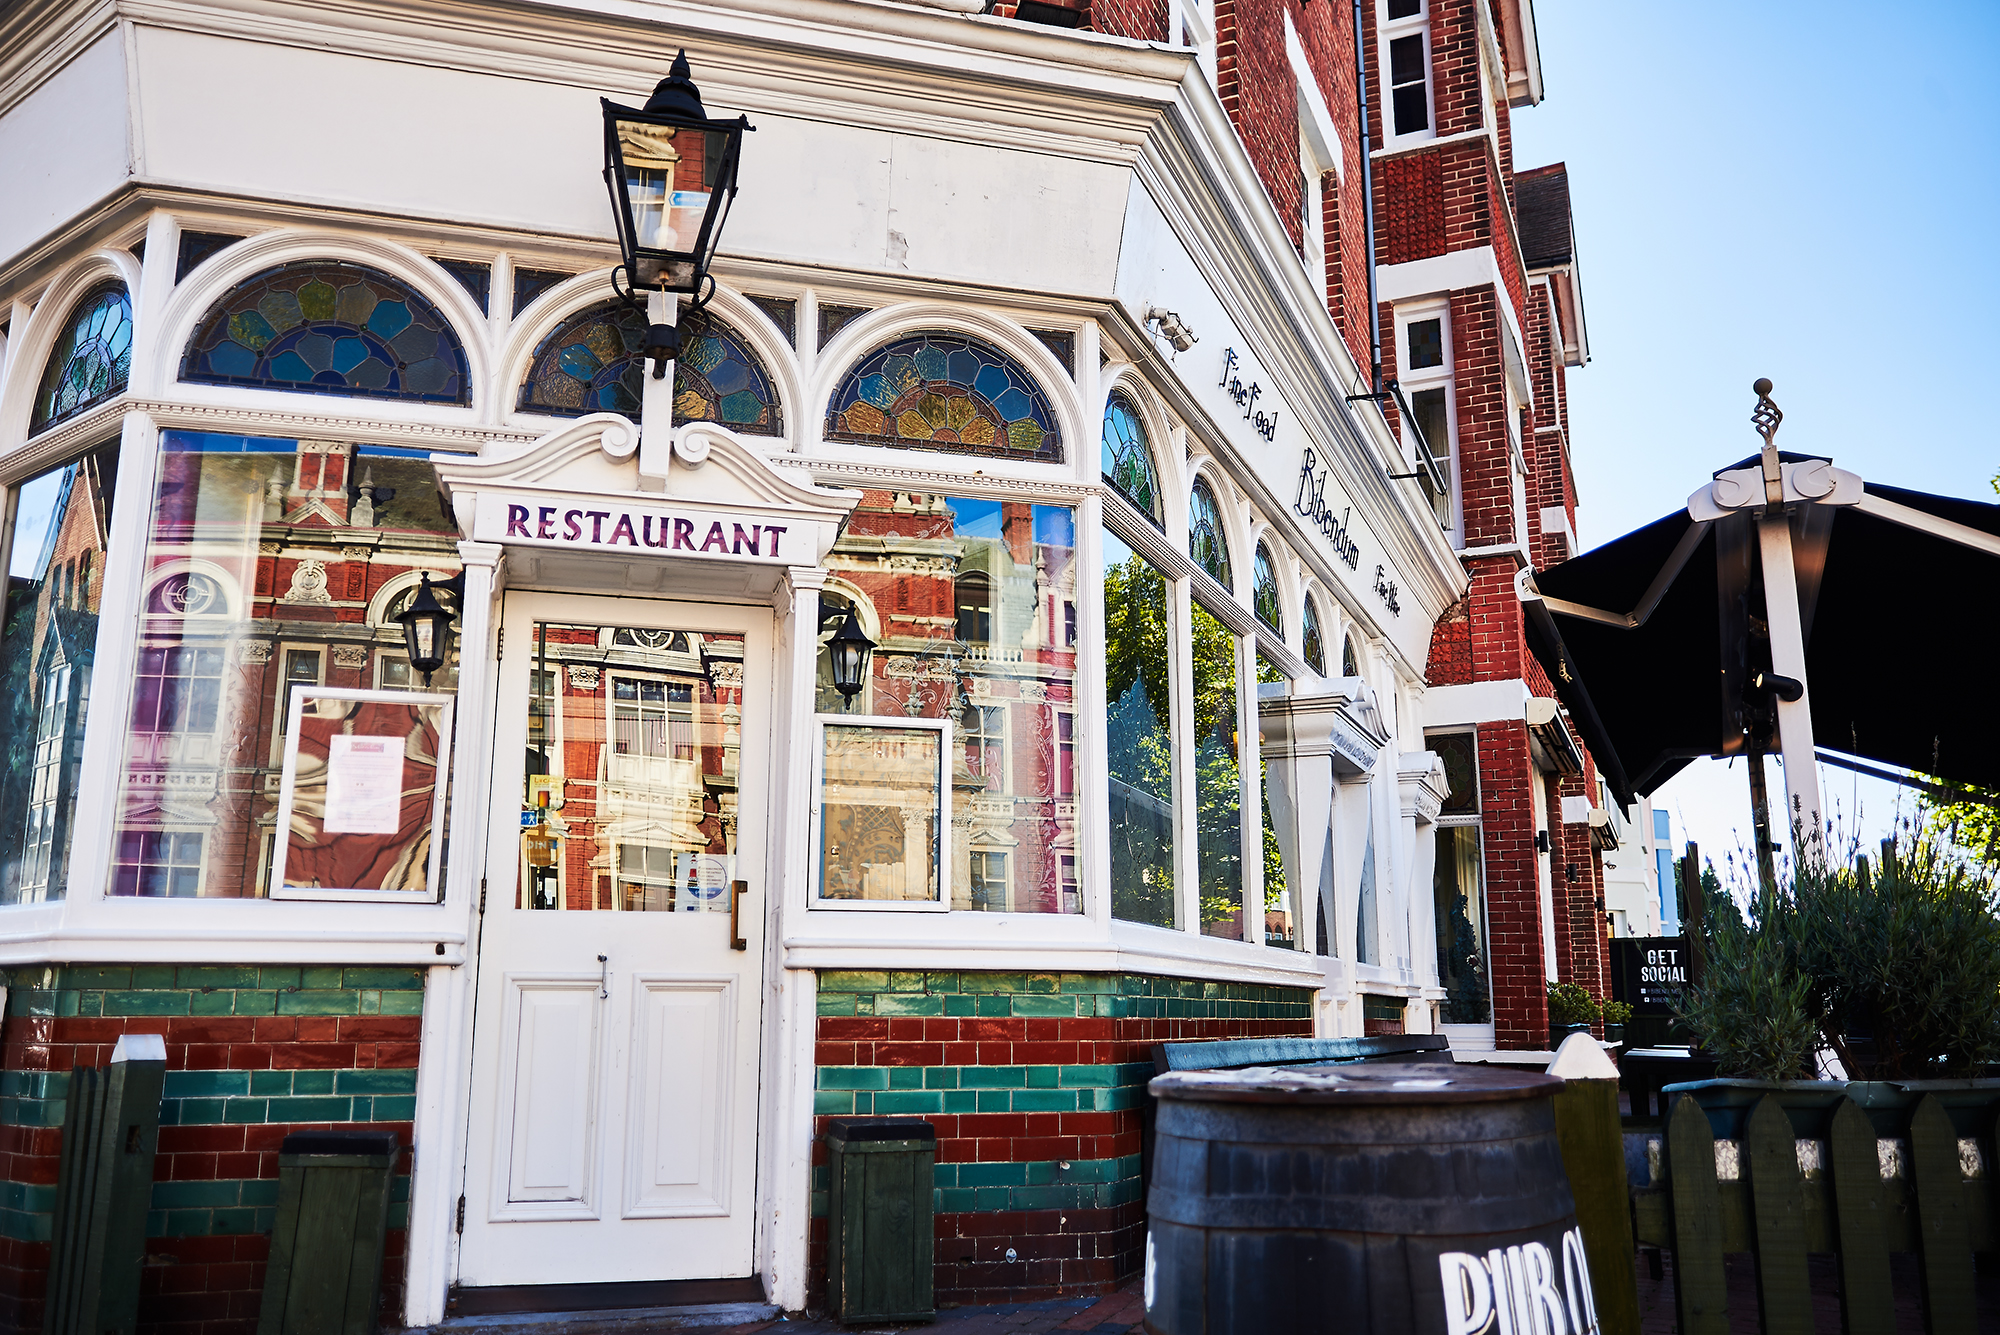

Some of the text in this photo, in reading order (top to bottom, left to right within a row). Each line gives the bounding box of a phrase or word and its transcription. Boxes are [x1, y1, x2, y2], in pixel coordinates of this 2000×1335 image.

[1219, 347, 1278, 442] Fine Food
[505, 503, 788, 558] RESTAURANT
[1293, 446, 1360, 571] Bibendum
[1640, 966, 1687, 982] SOCIAL
[1647, 949, 1679, 965] GET
